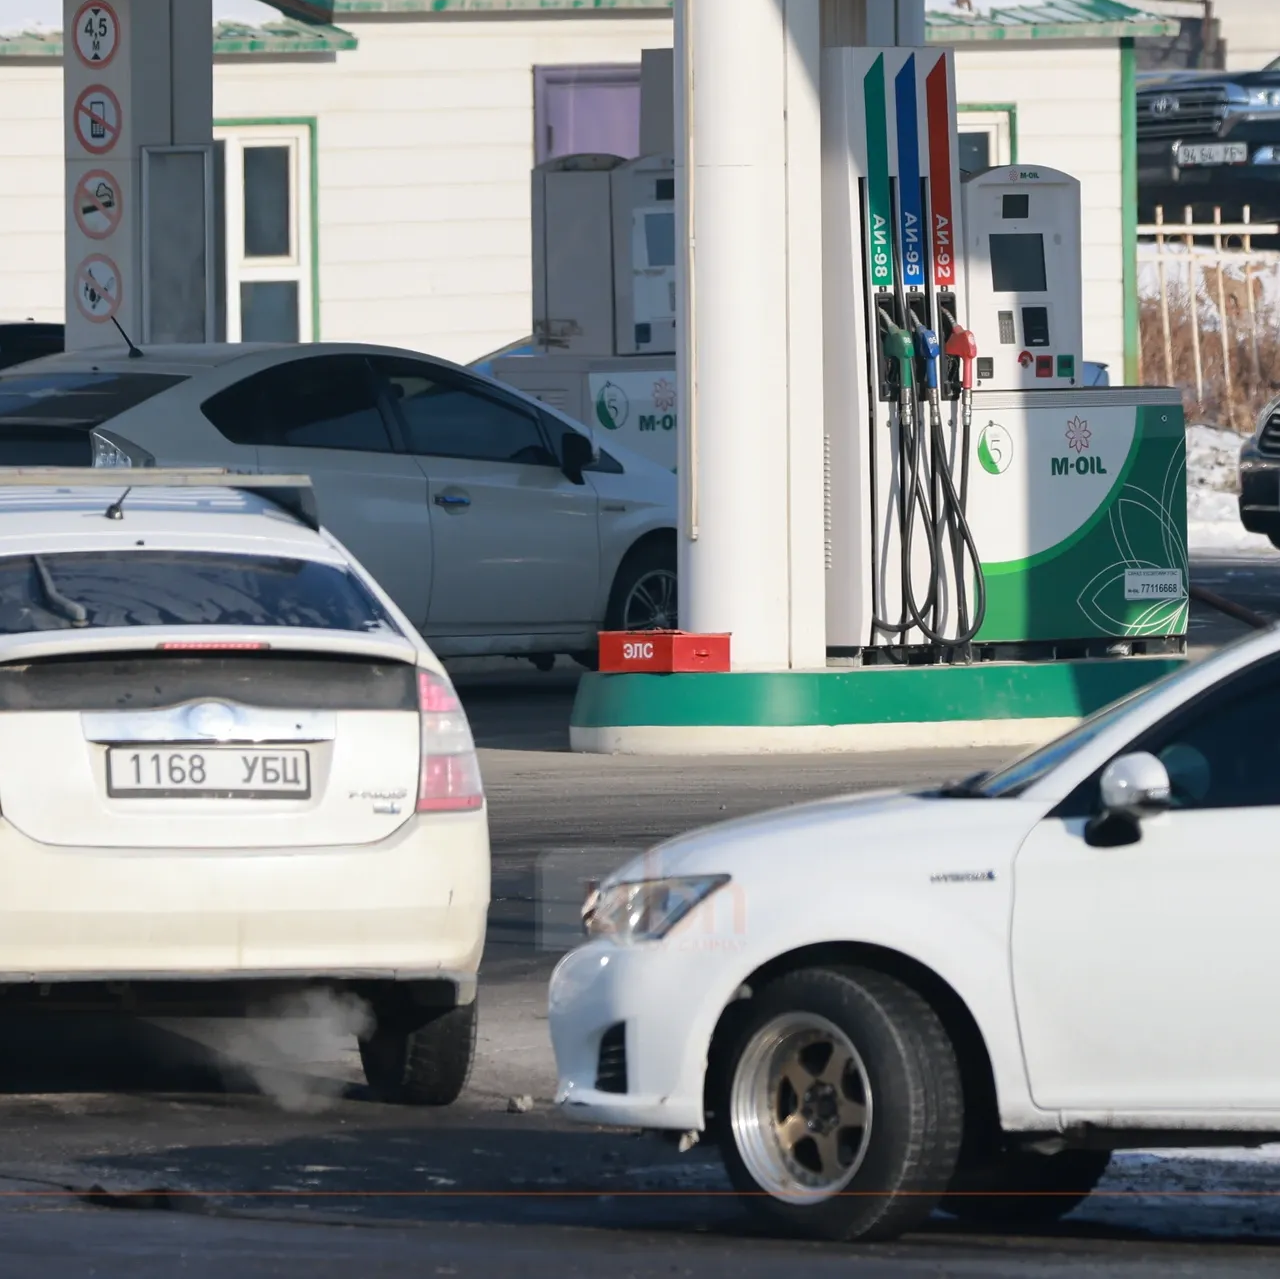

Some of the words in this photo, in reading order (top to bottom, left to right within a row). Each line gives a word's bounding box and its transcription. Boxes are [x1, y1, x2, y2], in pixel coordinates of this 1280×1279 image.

[84, 17, 107, 39] 4,5
[873, 213, 888, 278] АИ-98
[904, 211, 920, 276] АИ-95
[935, 213, 951, 278] АИ-92
[1051, 455, 1107, 476] M-OIL
[1141, 583, 1178, 593] 77116668
[623, 642, 654, 659] ЭЛС
[130, 753, 206, 785] 1168
[241, 756, 301, 786] УБЦ
